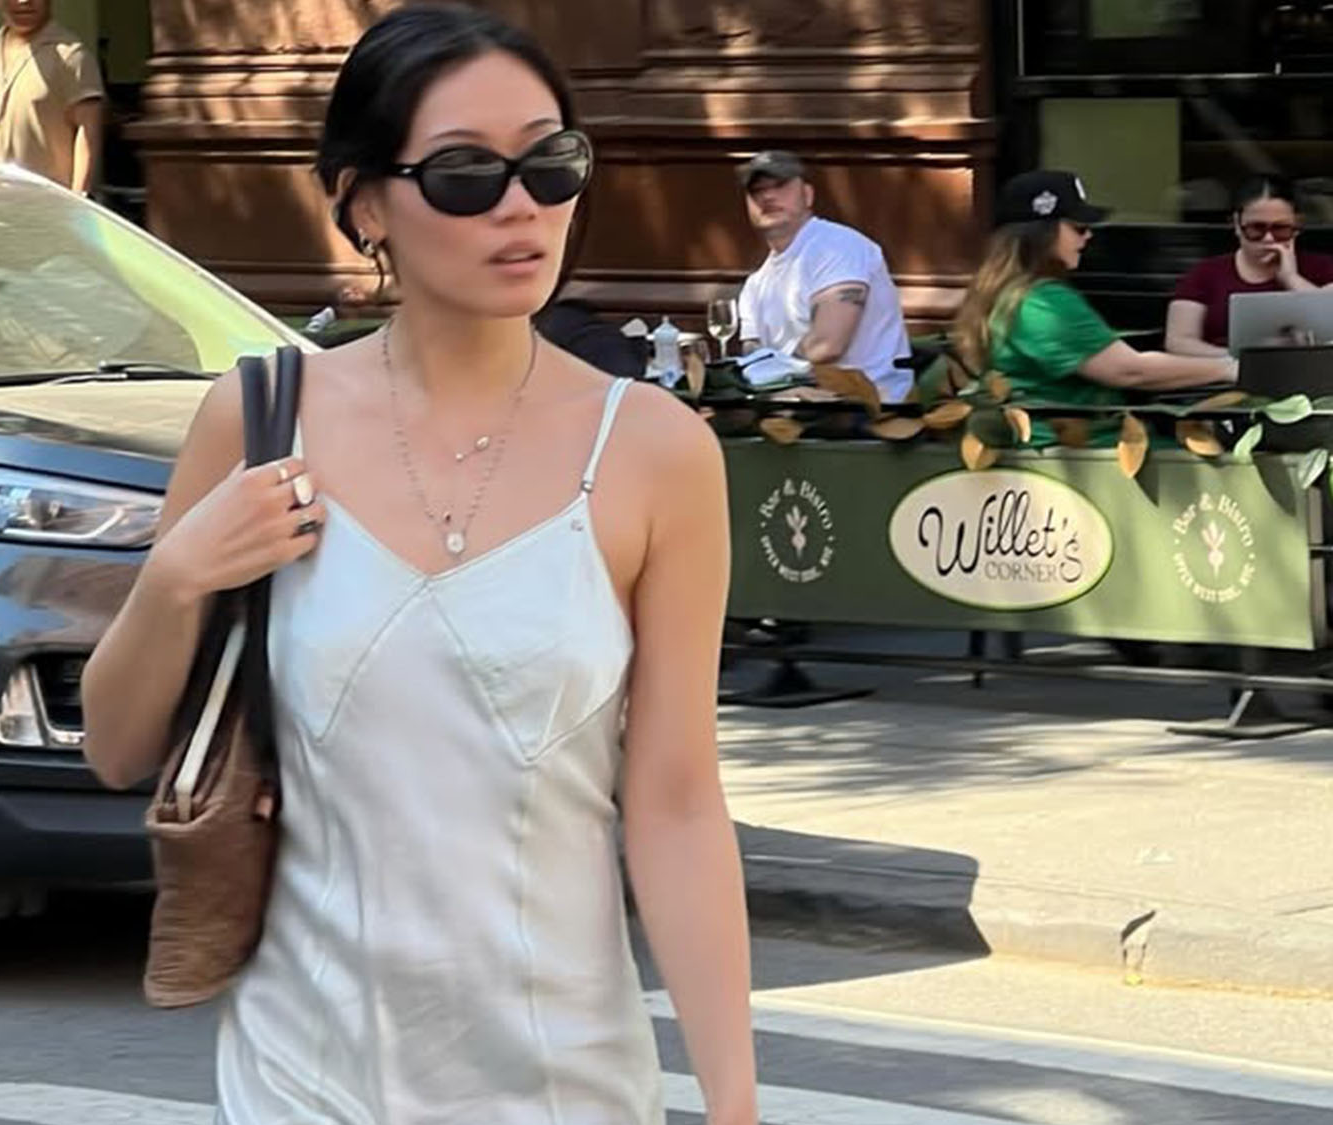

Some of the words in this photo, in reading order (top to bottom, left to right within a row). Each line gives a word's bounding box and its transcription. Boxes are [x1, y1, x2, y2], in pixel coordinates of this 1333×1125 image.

[758, 488, 781, 518] Bar
[1172, 503, 1196, 535] Bar
[918, 489, 1082, 582] Willet's
[984, 560, 1058, 582] CORNER
